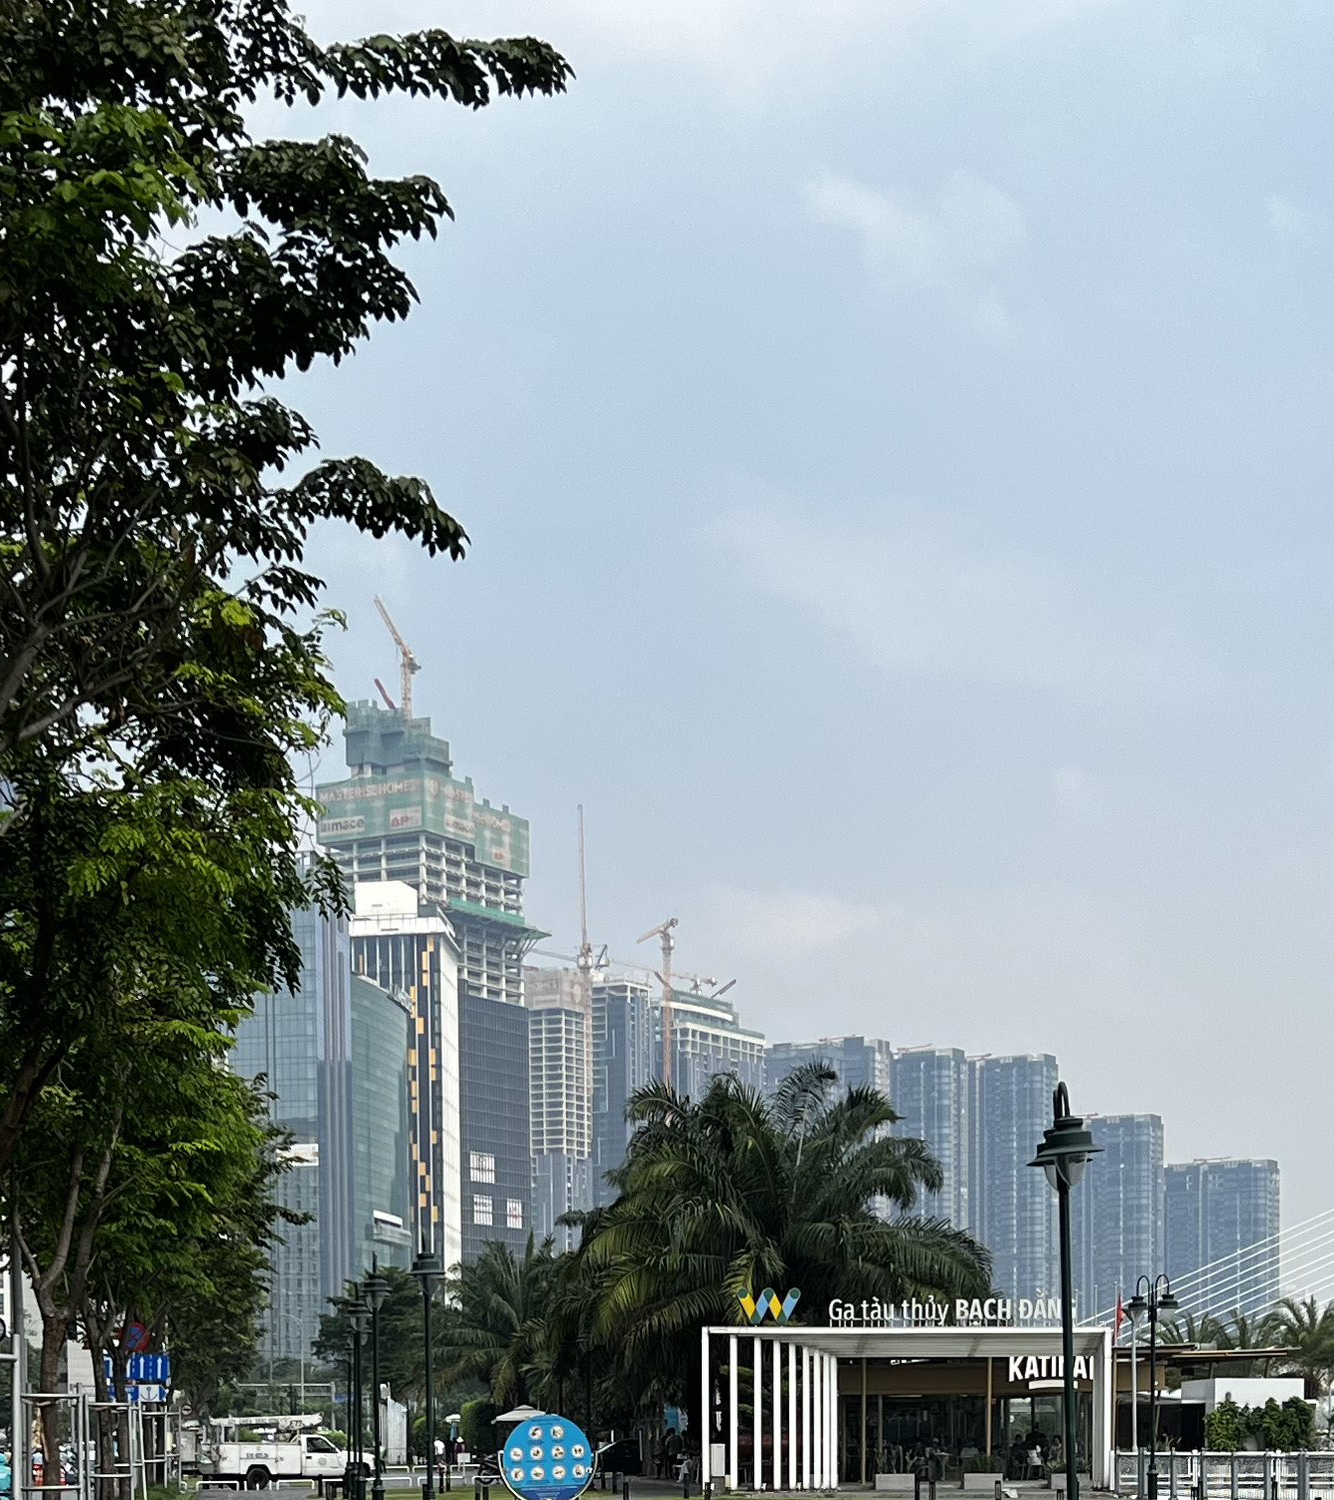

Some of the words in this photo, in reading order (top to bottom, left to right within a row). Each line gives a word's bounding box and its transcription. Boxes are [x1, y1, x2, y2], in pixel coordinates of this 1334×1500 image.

[829, 1298, 855, 1321] Ga
[862, 1296, 895, 1321] tàu
[901, 1295, 949, 1326] thủy
[955, 1298, 1011, 1327] BẠCH
